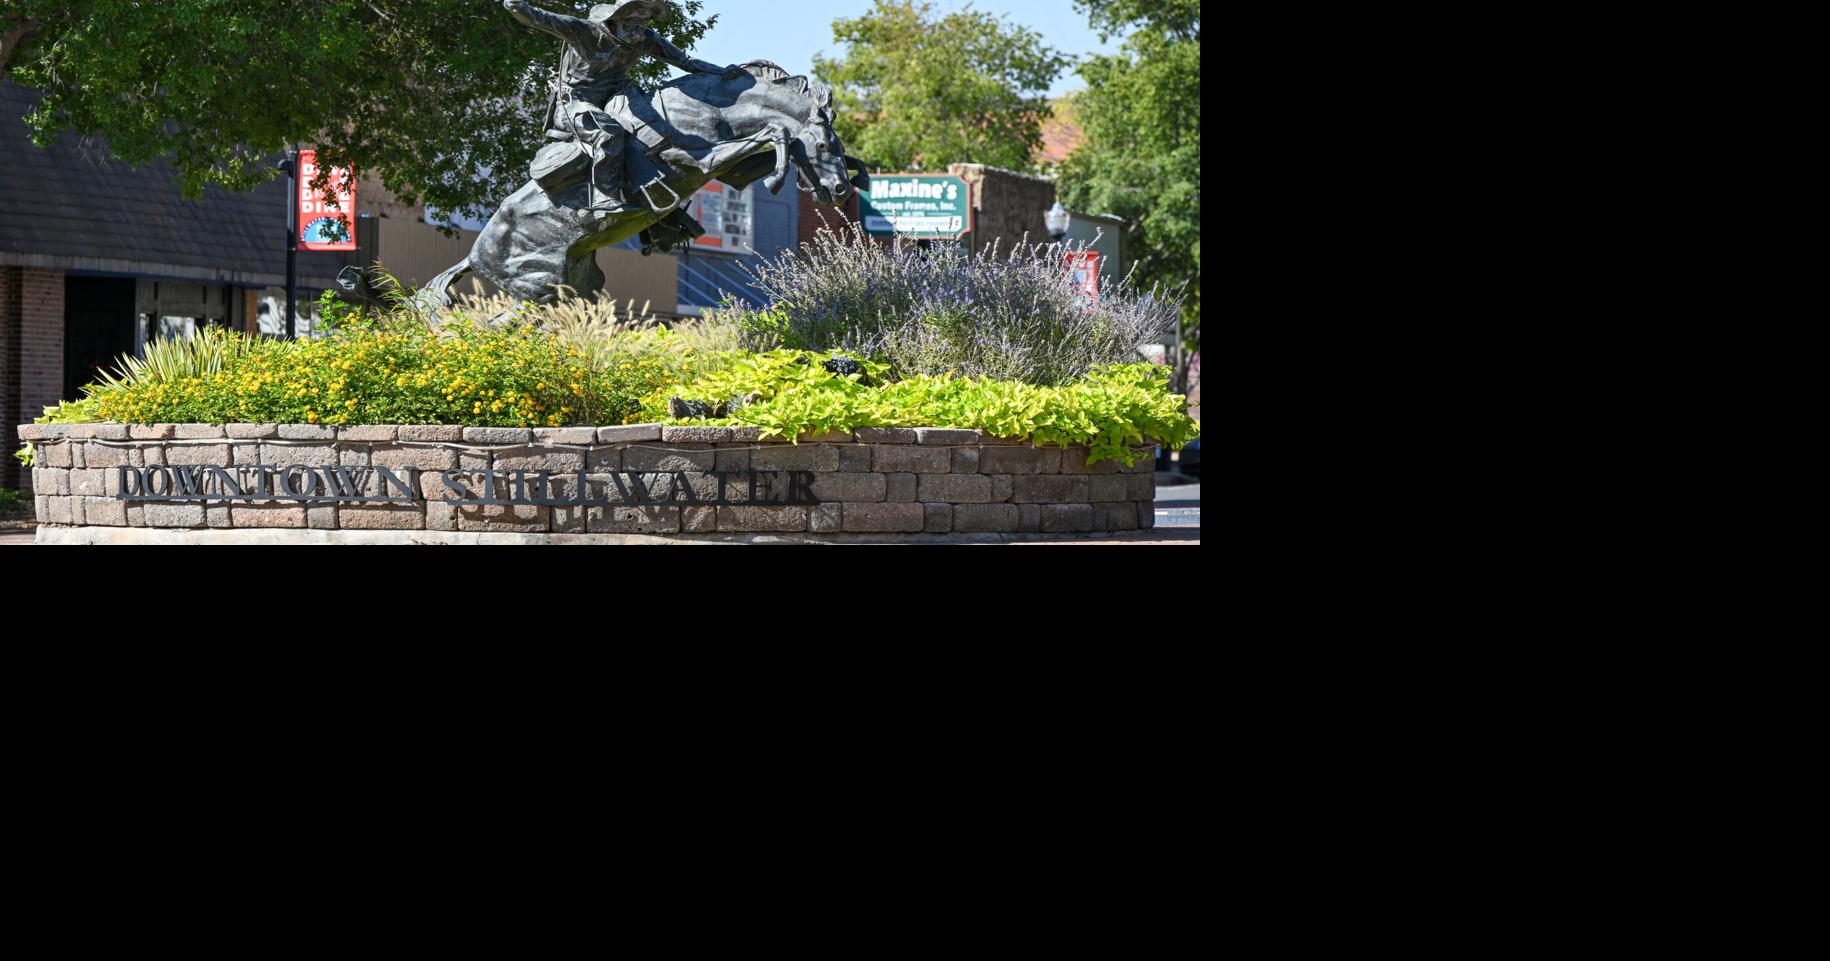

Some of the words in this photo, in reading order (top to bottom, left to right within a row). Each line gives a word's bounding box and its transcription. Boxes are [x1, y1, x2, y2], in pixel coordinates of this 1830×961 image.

[871, 179, 957, 200] Maxine's
[871, 200, 903, 210] Custom
[116, 464, 415, 500] DOWNTOWN
[442, 468, 821, 504] STILLWATER
